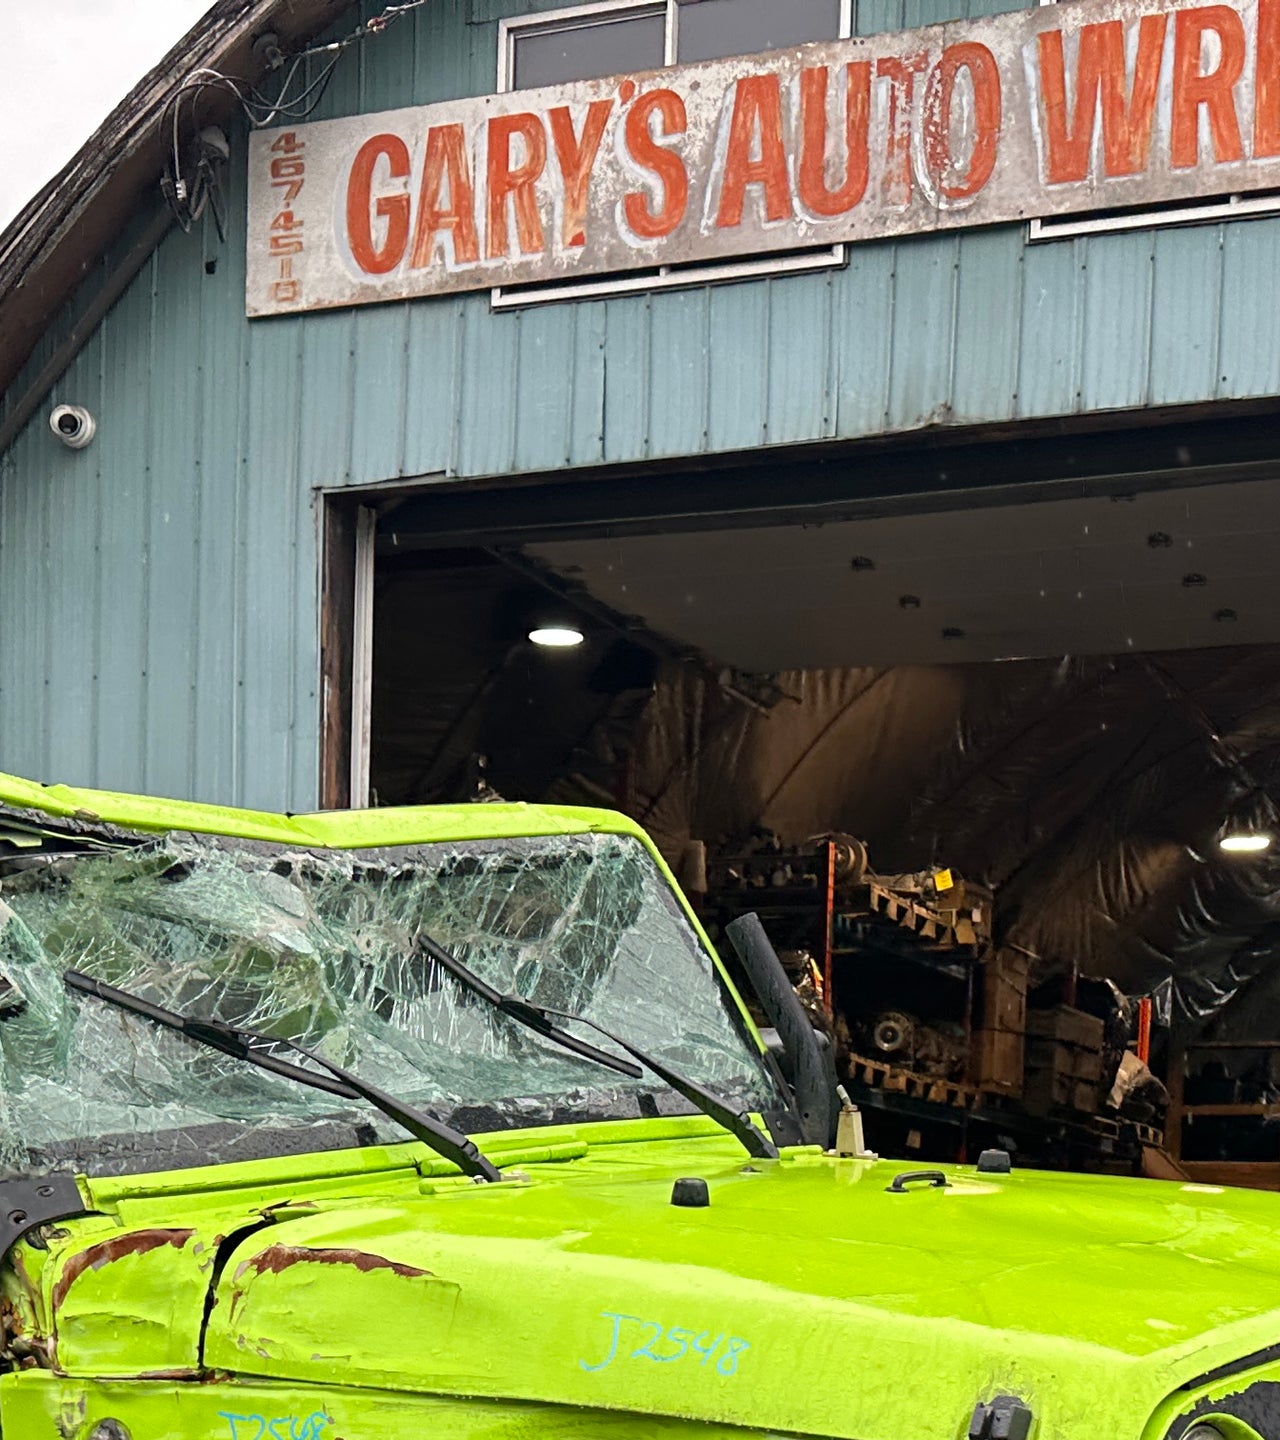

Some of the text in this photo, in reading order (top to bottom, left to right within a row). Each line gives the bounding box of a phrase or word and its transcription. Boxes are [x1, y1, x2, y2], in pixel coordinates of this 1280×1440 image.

[345, 80, 688, 275] GARY'S
[717, 40, 1003, 228] AUTO
[579, 1311, 751, 1376] J2548
